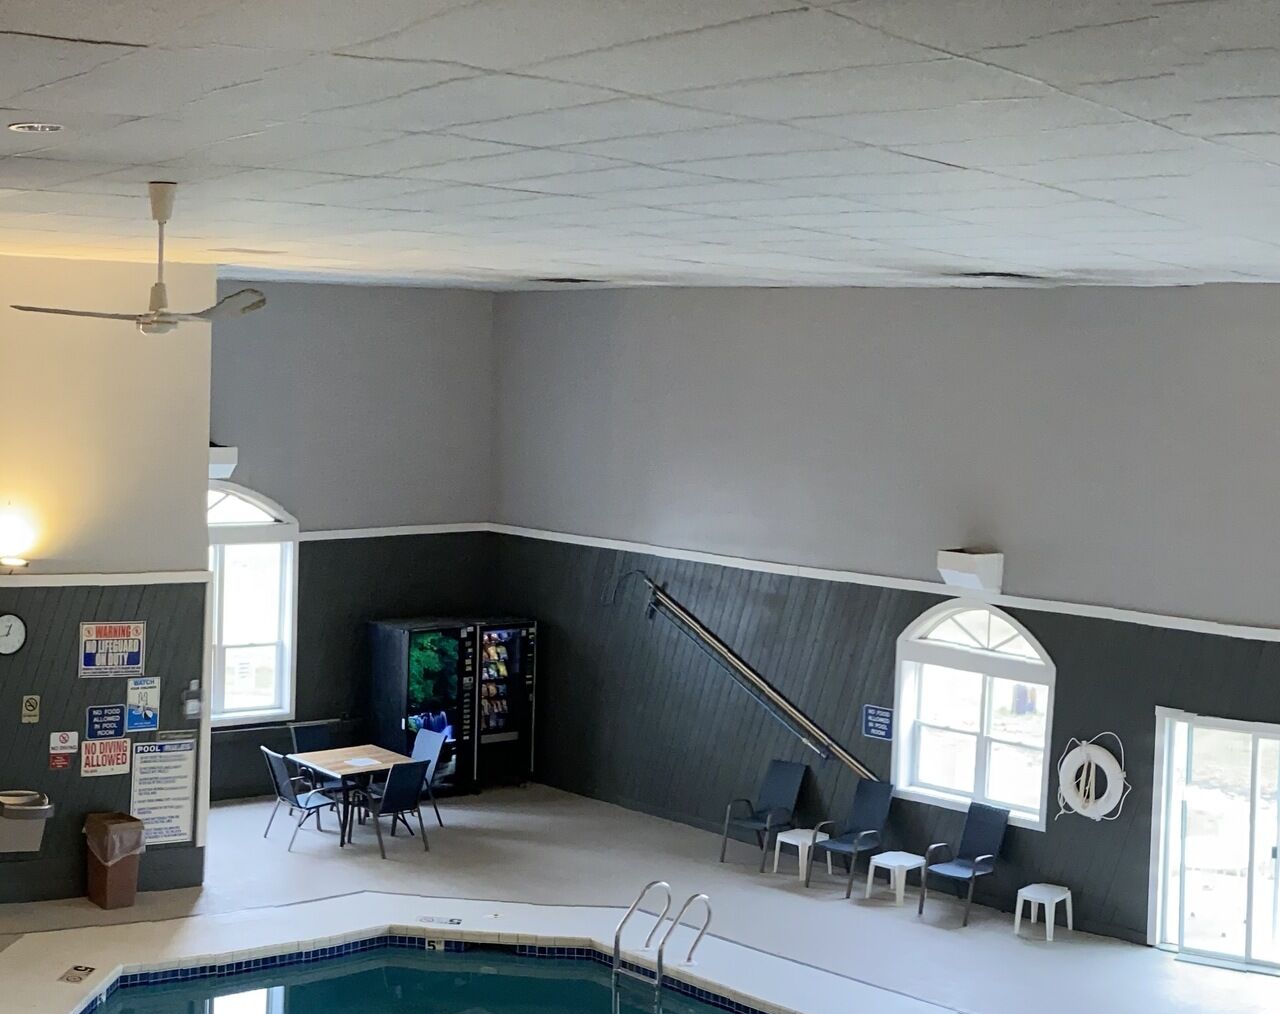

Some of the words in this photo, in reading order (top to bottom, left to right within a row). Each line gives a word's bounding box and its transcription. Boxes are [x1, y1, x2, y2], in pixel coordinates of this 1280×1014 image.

[96, 626, 131, 638] WARNING
[85, 640, 97, 654] NO
[98, 639, 139, 653] LIFEGUARD
[95, 652, 107, 666] ON
[108, 652, 128, 666] DUTY
[84, 742, 96, 754] NO
[100, 740, 128, 754] DIVING
[136, 745, 160, 753] POOL
[84, 753, 128, 768] ALLOWED
[428, 940, 436, 950] 5
[73, 965, 96, 973] 5
